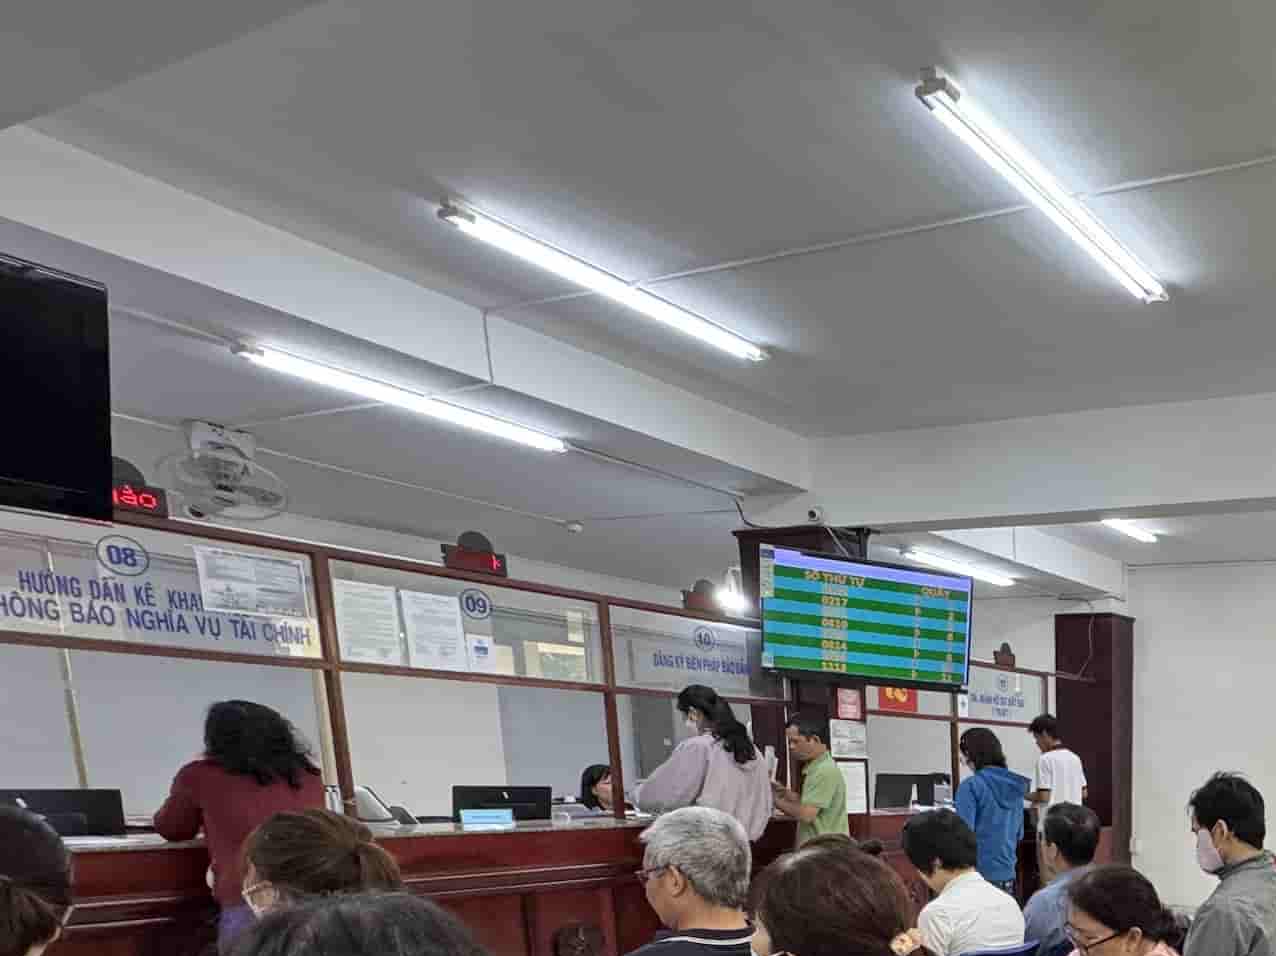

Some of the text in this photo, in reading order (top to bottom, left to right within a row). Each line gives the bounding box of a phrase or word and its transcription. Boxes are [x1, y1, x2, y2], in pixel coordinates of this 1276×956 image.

[106, 544, 138, 567] 08
[0, 590, 61, 621] HÔNG
[465, 595, 488, 614] 09
